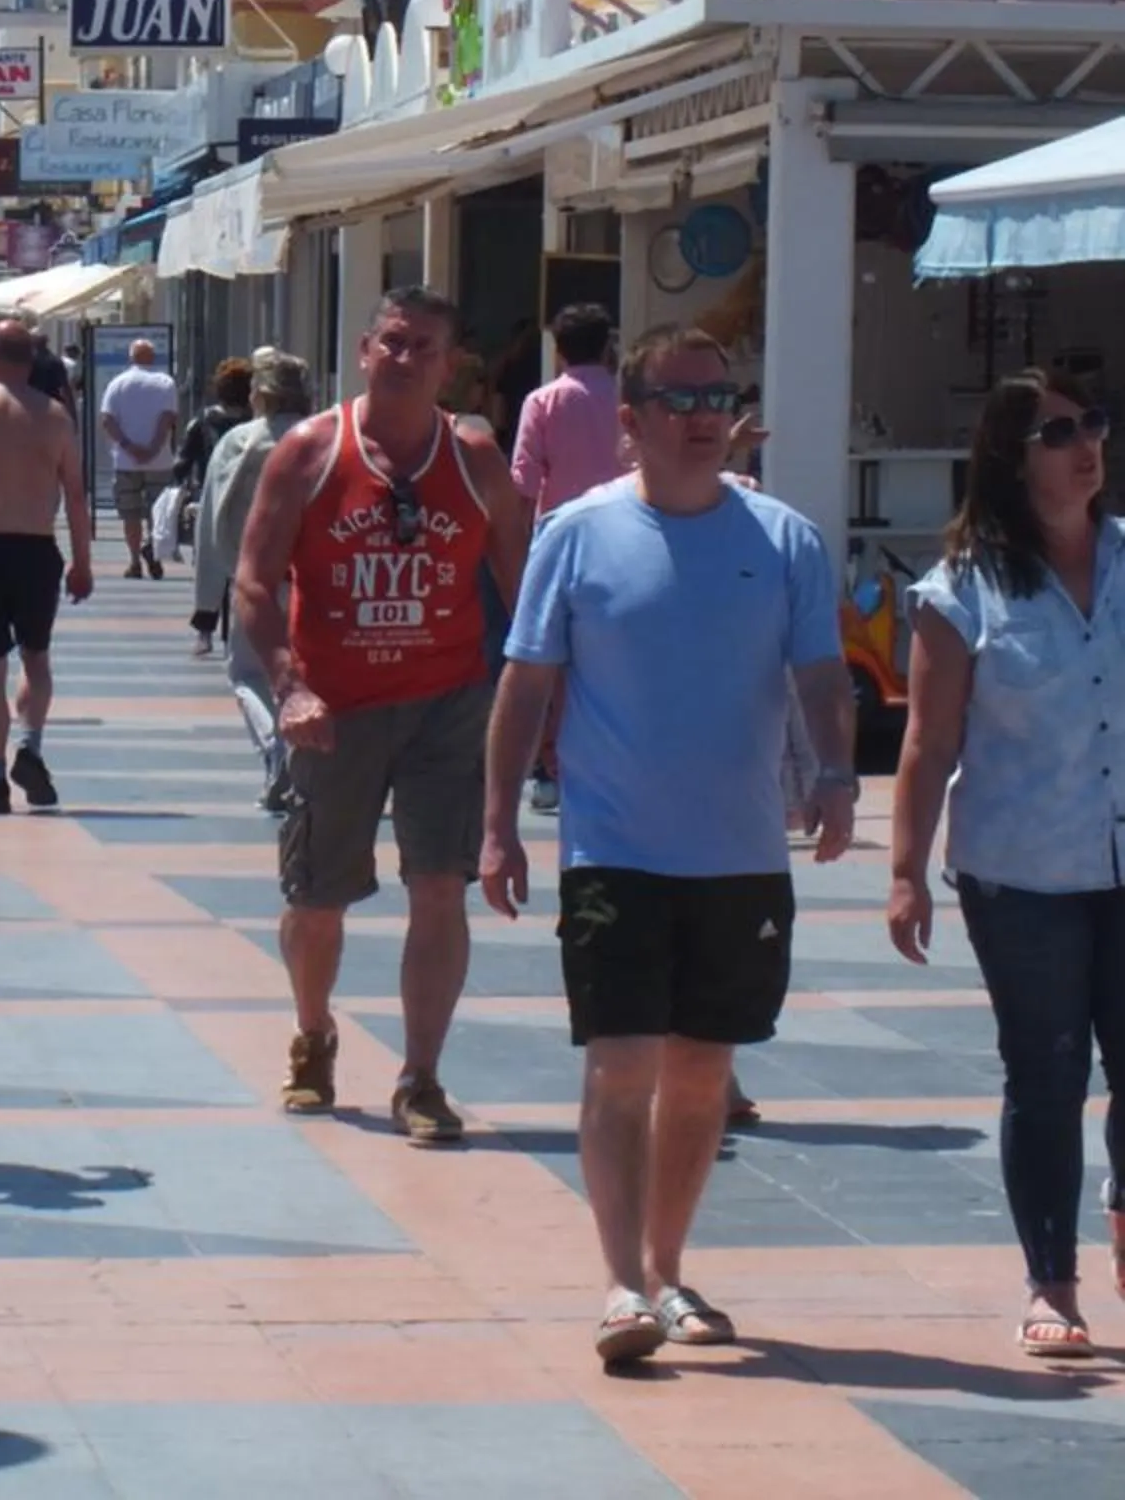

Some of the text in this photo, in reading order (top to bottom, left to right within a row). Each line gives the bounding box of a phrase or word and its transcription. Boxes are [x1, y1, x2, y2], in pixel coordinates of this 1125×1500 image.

[328, 504, 463, 544] KICK ACK
[351, 553, 435, 599] NYC
[372, 604, 410, 623] 101
